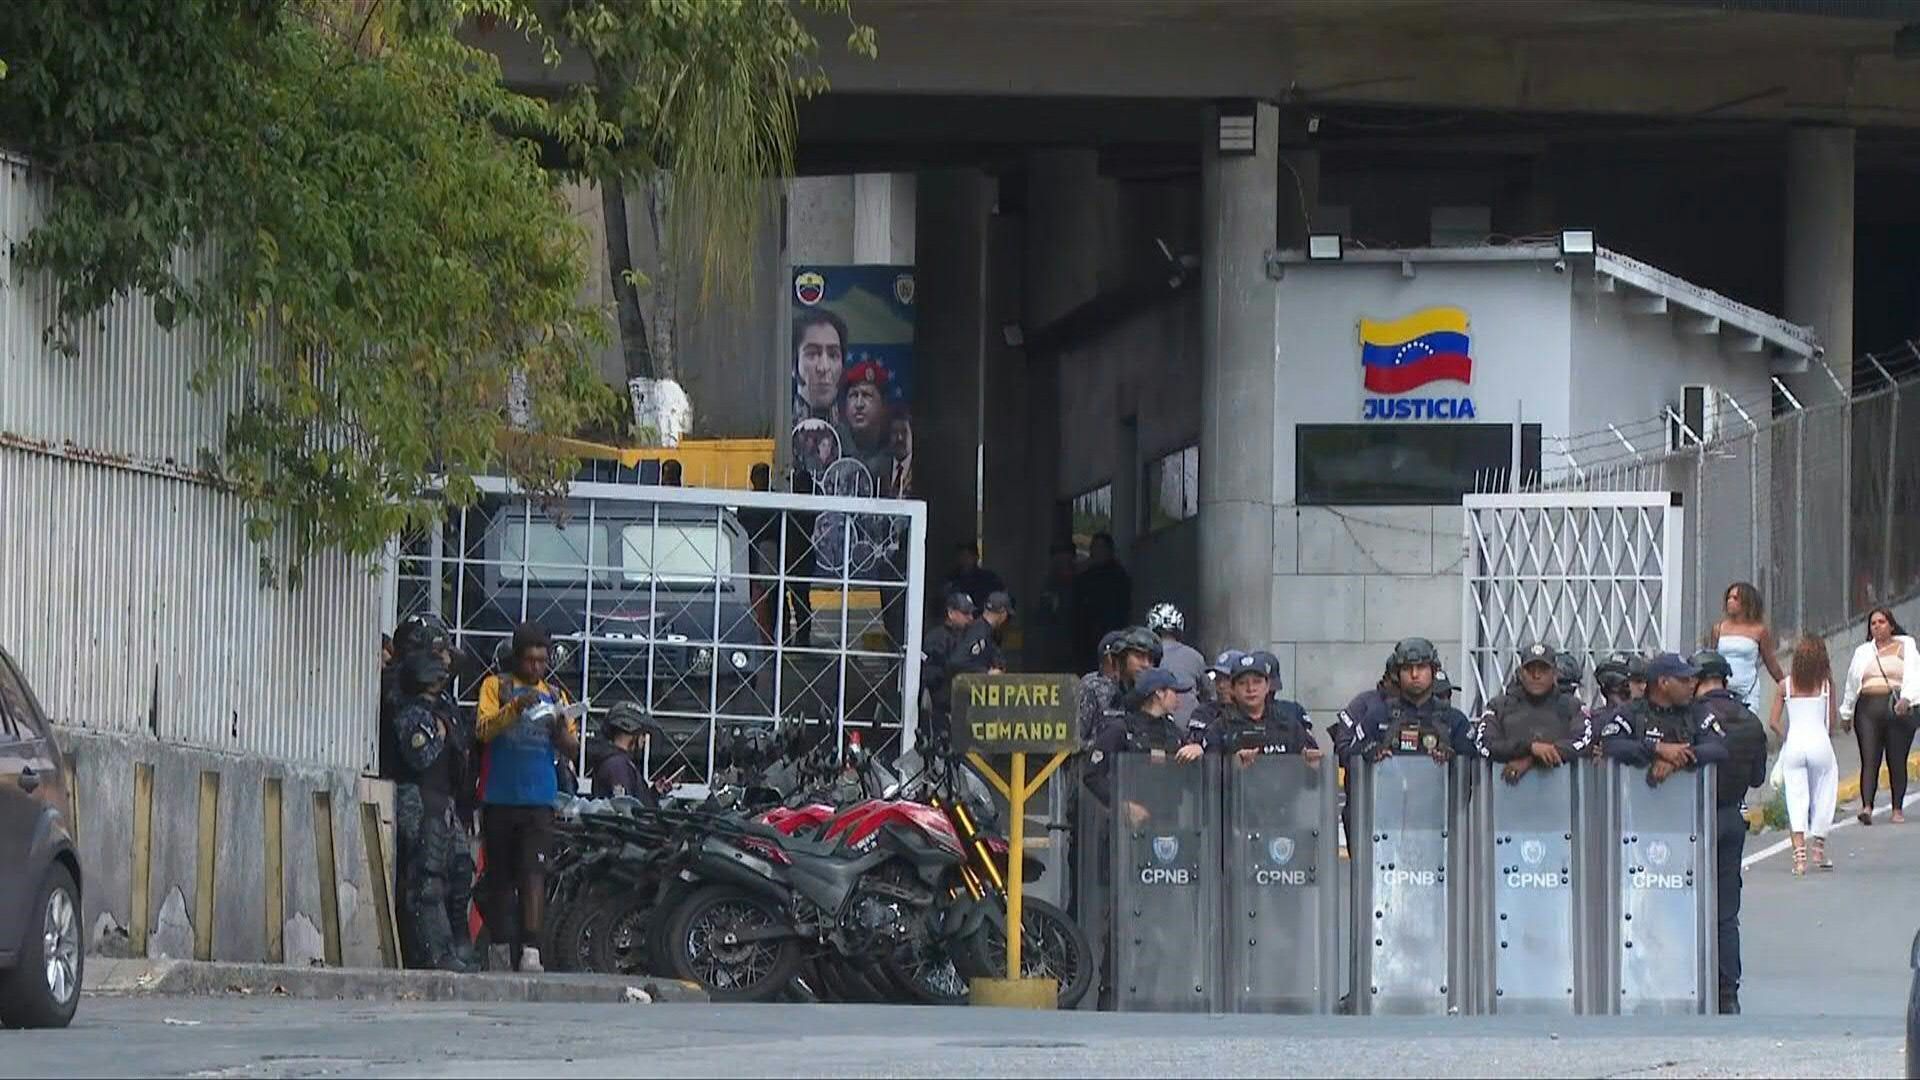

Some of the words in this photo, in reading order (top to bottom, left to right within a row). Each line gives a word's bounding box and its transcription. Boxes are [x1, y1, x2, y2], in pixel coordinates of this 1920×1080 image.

[1364, 398, 1475, 419] JUSTICIA
[971, 685, 999, 706] NO
[1004, 685, 1059, 706] PARE
[971, 723, 1066, 740] COMANDO
[1141, 868, 1189, 884] CPNB
[1256, 869, 1306, 884] CPNB
[1383, 870, 1434, 885] CPNB
[1507, 872, 1558, 888] CPNB
[1632, 872, 1683, 888] CPNB
